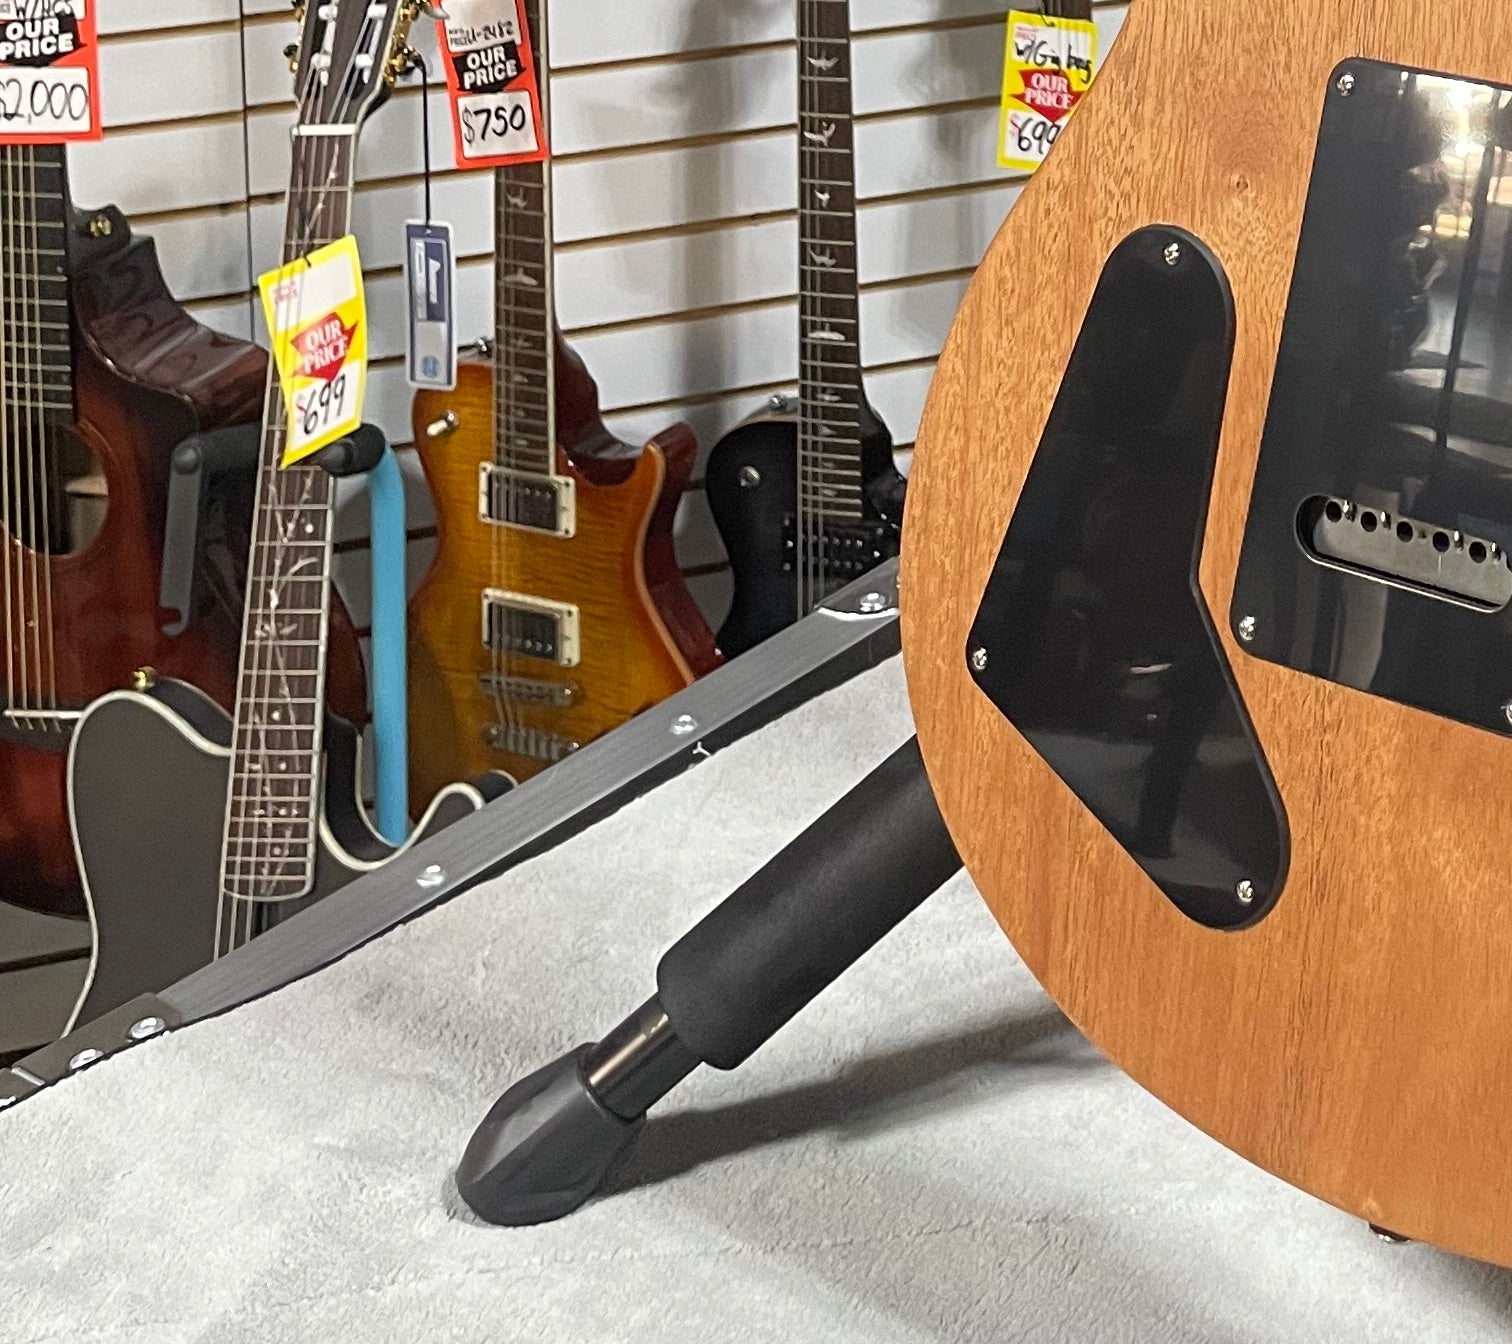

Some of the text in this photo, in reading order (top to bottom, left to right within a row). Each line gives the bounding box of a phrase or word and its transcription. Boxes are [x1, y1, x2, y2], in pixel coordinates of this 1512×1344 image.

[5, 18, 60, 41] OUR
[0, 32, 74, 60] PRICE
[466, 46, 507, 70] OUR
[462, 59, 518, 90] PRICE
[1031, 72, 1069, 93] OUR
[1025, 87, 1075, 110] PRICE
[461, 103, 527, 146] $750
[304, 319, 342, 348] OUR
[303, 336, 349, 375] PRICE
[295, 372, 347, 435] $699
